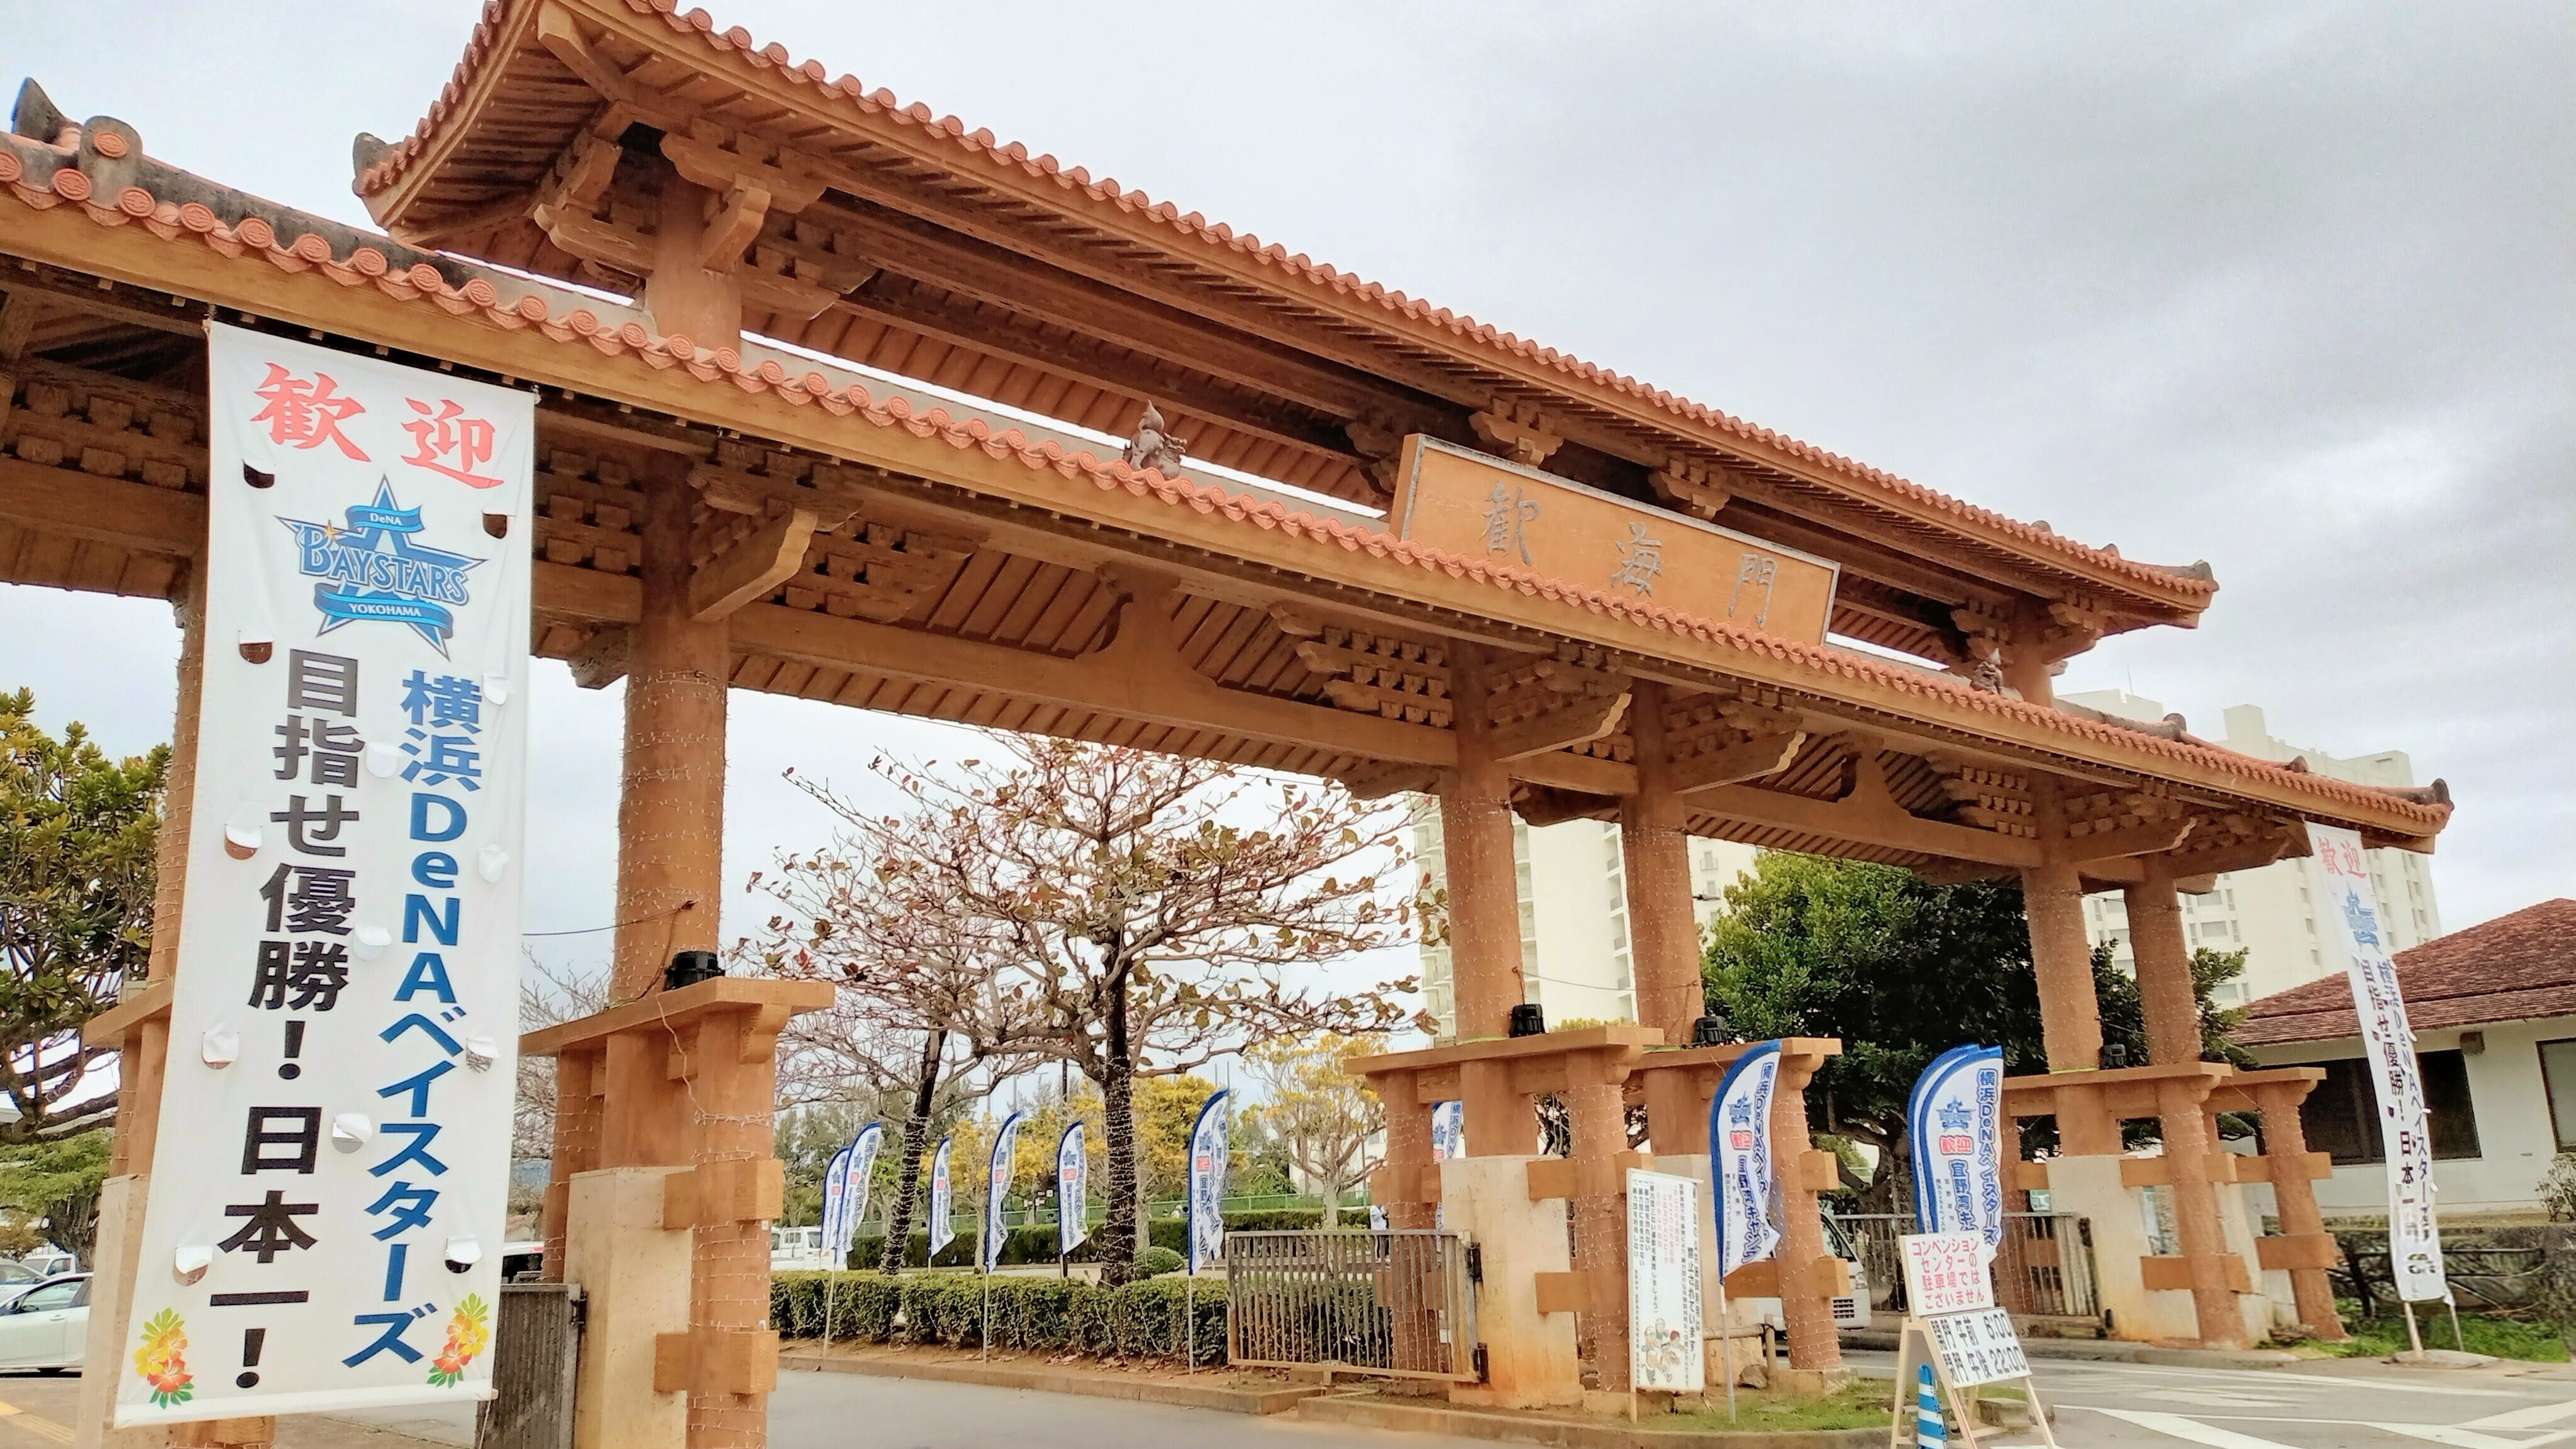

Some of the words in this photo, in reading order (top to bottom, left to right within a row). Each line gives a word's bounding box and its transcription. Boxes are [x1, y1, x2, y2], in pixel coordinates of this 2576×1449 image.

[250, 362, 505, 489] 歓迎
[369, 513, 403, 526] DeNA
[296, 526, 469, 606] BAYSTARS
[348, 603, 422, 618] YOKOHAMA
[2318, 835, 2367, 879] 歓迎
[341, 669, 482, 1371] 横浜DeNAベイスターズ
[1941, 1137, 1972, 1153] 歓迎
[1979, 1070, 1998, 1245] 横浜DeNAベイスターズ
[1912, 1237, 1979, 1256] コンベンション
[1921, 1253, 1977, 1274] センターの
[1922, 1270, 1980, 1291] 駐車場では
[1953, 1316, 1979, 1347] 午前
[1983, 1313, 2012, 1340] 6:00
[1965, 1349, 1992, 1380] 午後
[1989, 1345, 2027, 1374] 22:00
